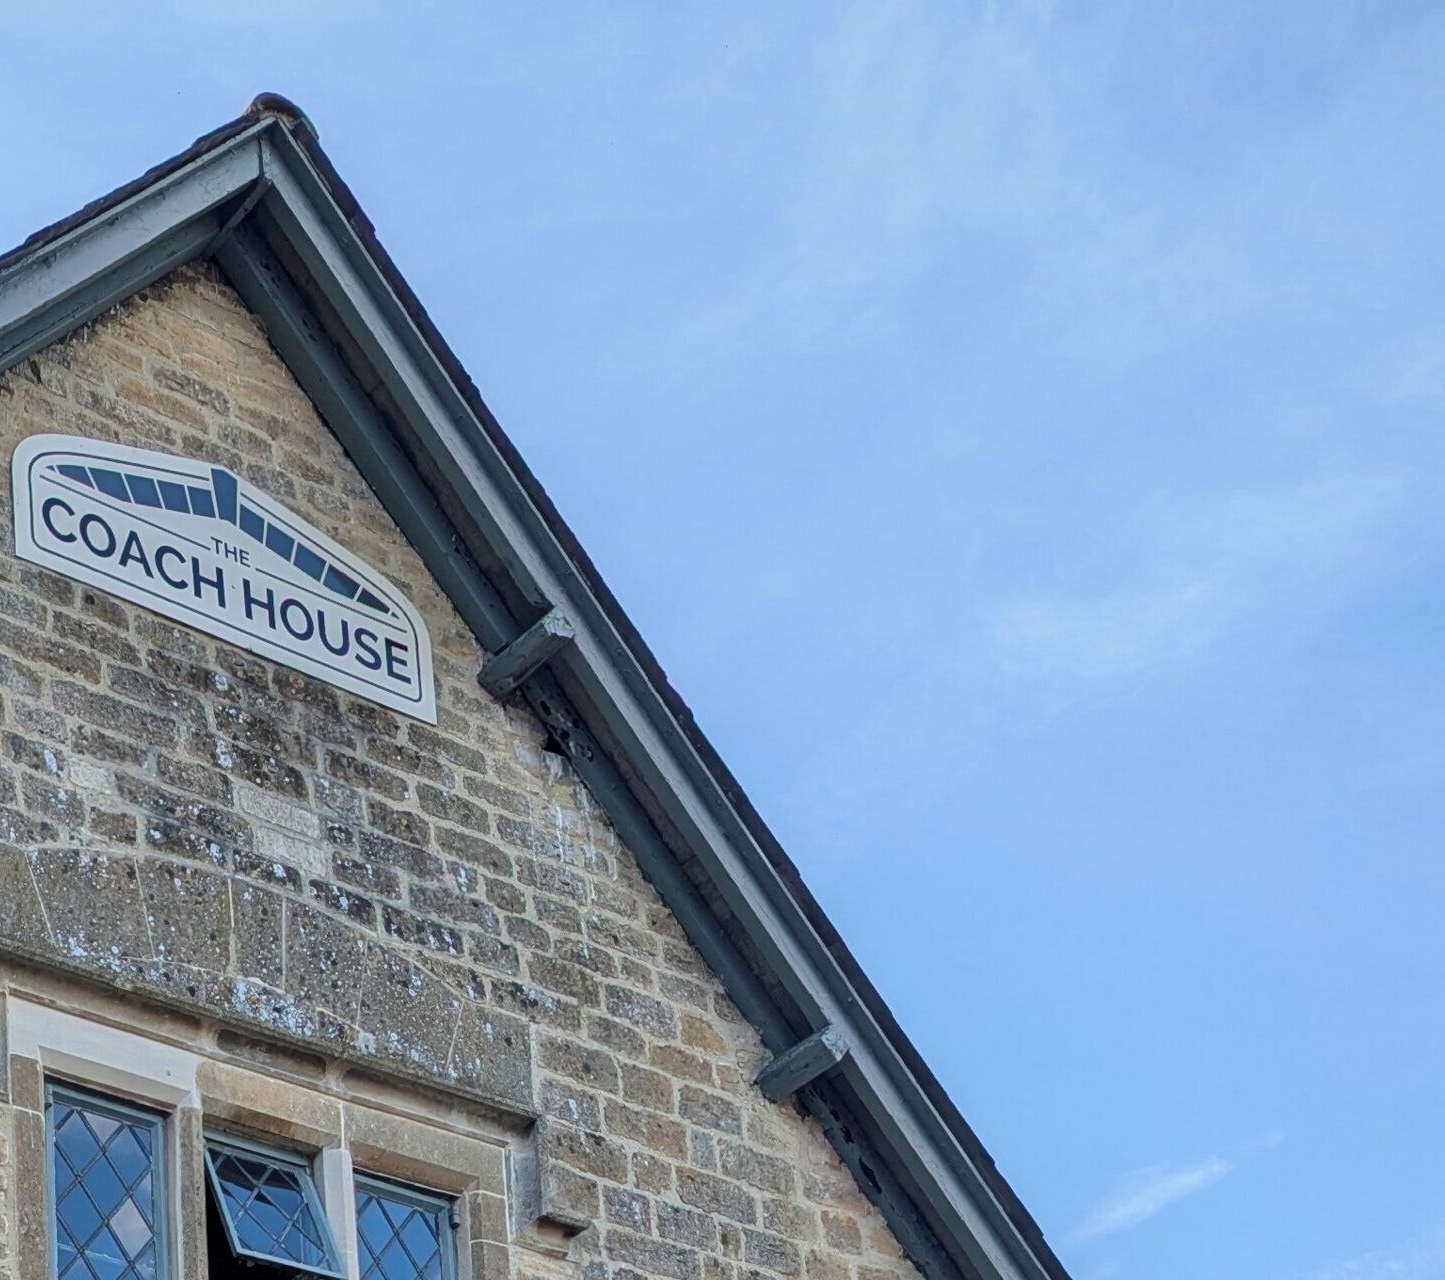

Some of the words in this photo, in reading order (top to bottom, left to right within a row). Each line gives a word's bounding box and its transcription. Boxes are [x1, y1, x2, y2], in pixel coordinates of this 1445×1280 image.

[41, 498, 226, 608] COACH
[243, 579, 412, 685] HOUSE
[210, 537, 250, 567] THE
